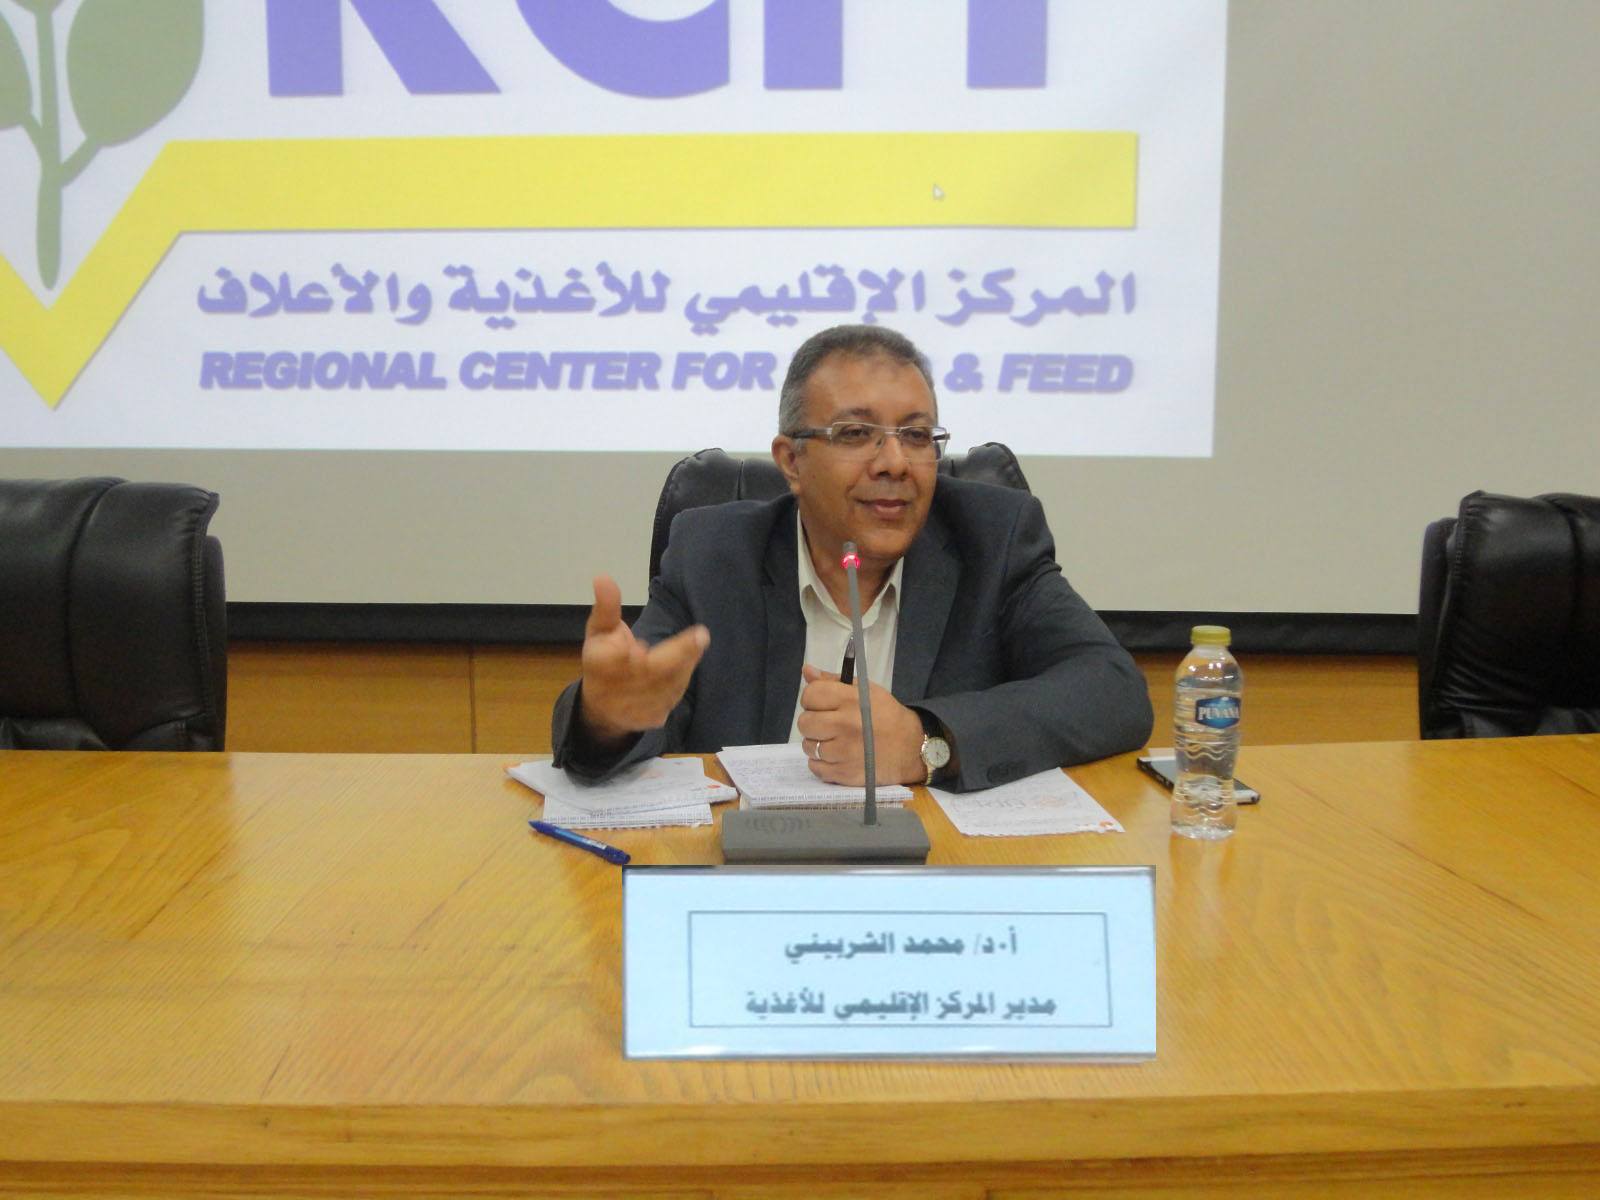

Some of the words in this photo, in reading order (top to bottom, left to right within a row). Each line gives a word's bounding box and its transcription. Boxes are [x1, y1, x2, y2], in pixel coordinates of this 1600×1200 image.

[198, 263, 433, 325] والأعلاف
[443, 261, 671, 329] للأغذية
[684, 265, 926, 334] الإقليمي
[938, 268, 1135, 326] المركز
[200, 350, 448, 390] REGIONAL
[459, 351, 662, 391] CENTER
[671, 351, 777, 390] FOR
[944, 352, 983, 392] &
[998, 353, 1132, 392] FEED
[785, 931, 895, 964] الشربيني
[903, 936, 965, 955] محمد
[746, 987, 825, 1020] للأغذية
[936, 990, 995, 1020] المركز
[1003, 996, 1057, 1020] مدير
